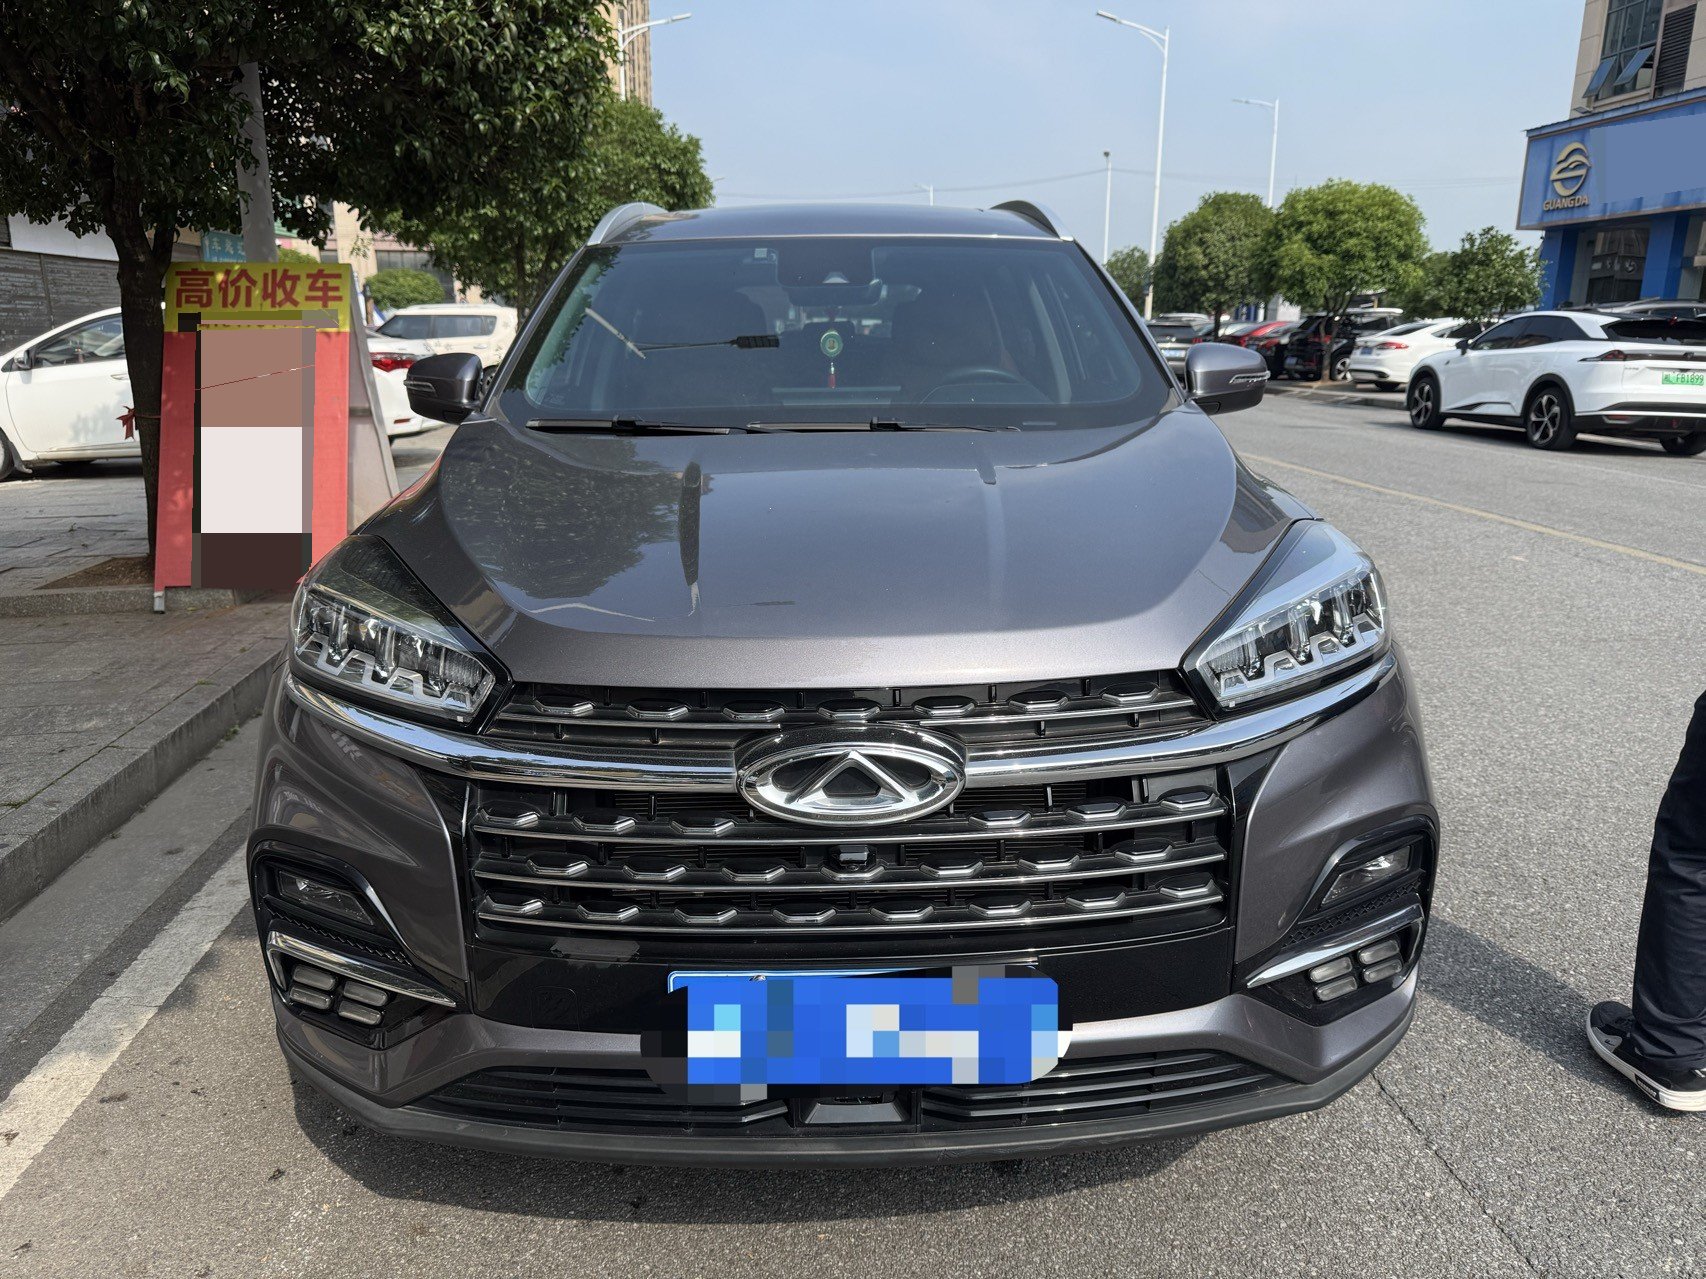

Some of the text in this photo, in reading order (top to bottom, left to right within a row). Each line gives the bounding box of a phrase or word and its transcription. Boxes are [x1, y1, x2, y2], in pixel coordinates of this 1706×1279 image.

[1543, 196, 1589, 211] GUANGDA
[175, 268, 343, 308] 高价收车
